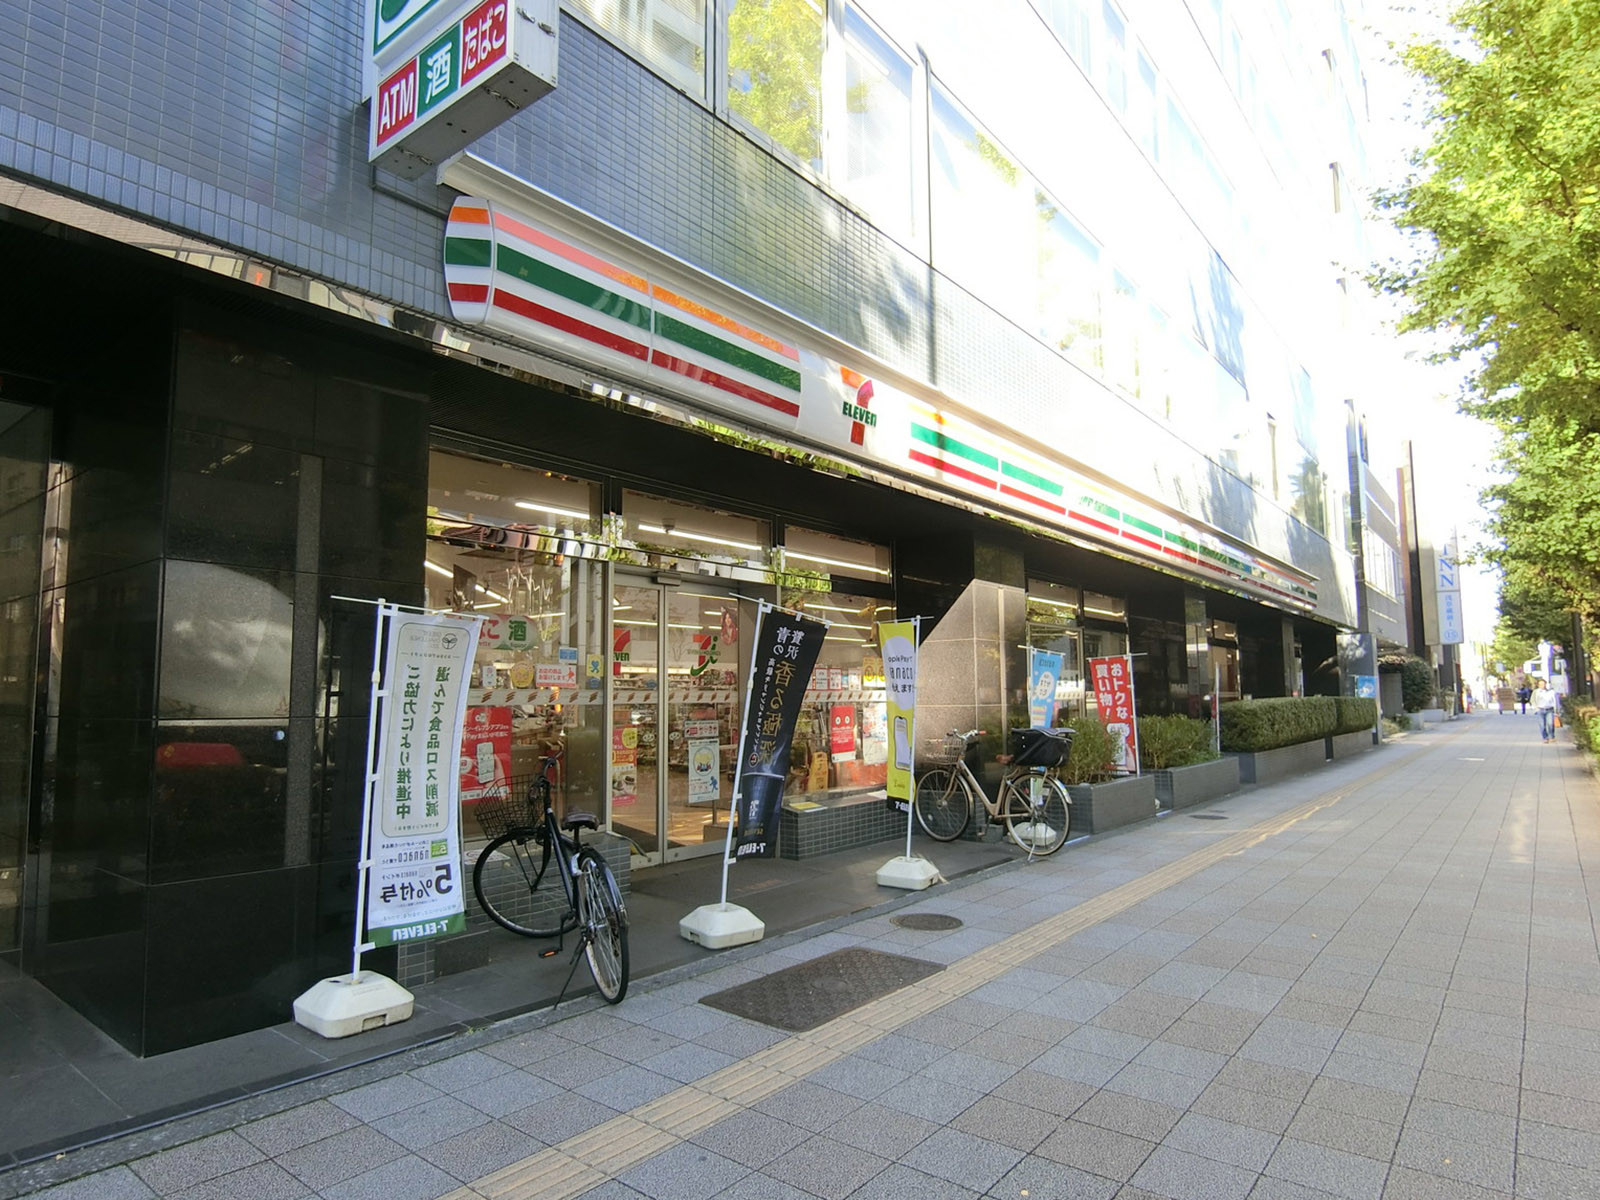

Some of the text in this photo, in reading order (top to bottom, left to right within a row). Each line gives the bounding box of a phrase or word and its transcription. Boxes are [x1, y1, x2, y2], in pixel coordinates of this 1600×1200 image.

[464, 4, 506, 74] たばこ
[379, 72, 414, 135] ATM
[425, 42, 452, 104] 酒
[508, 620, 527, 641] 酒
[1110, 663, 1129, 719] おトクな
